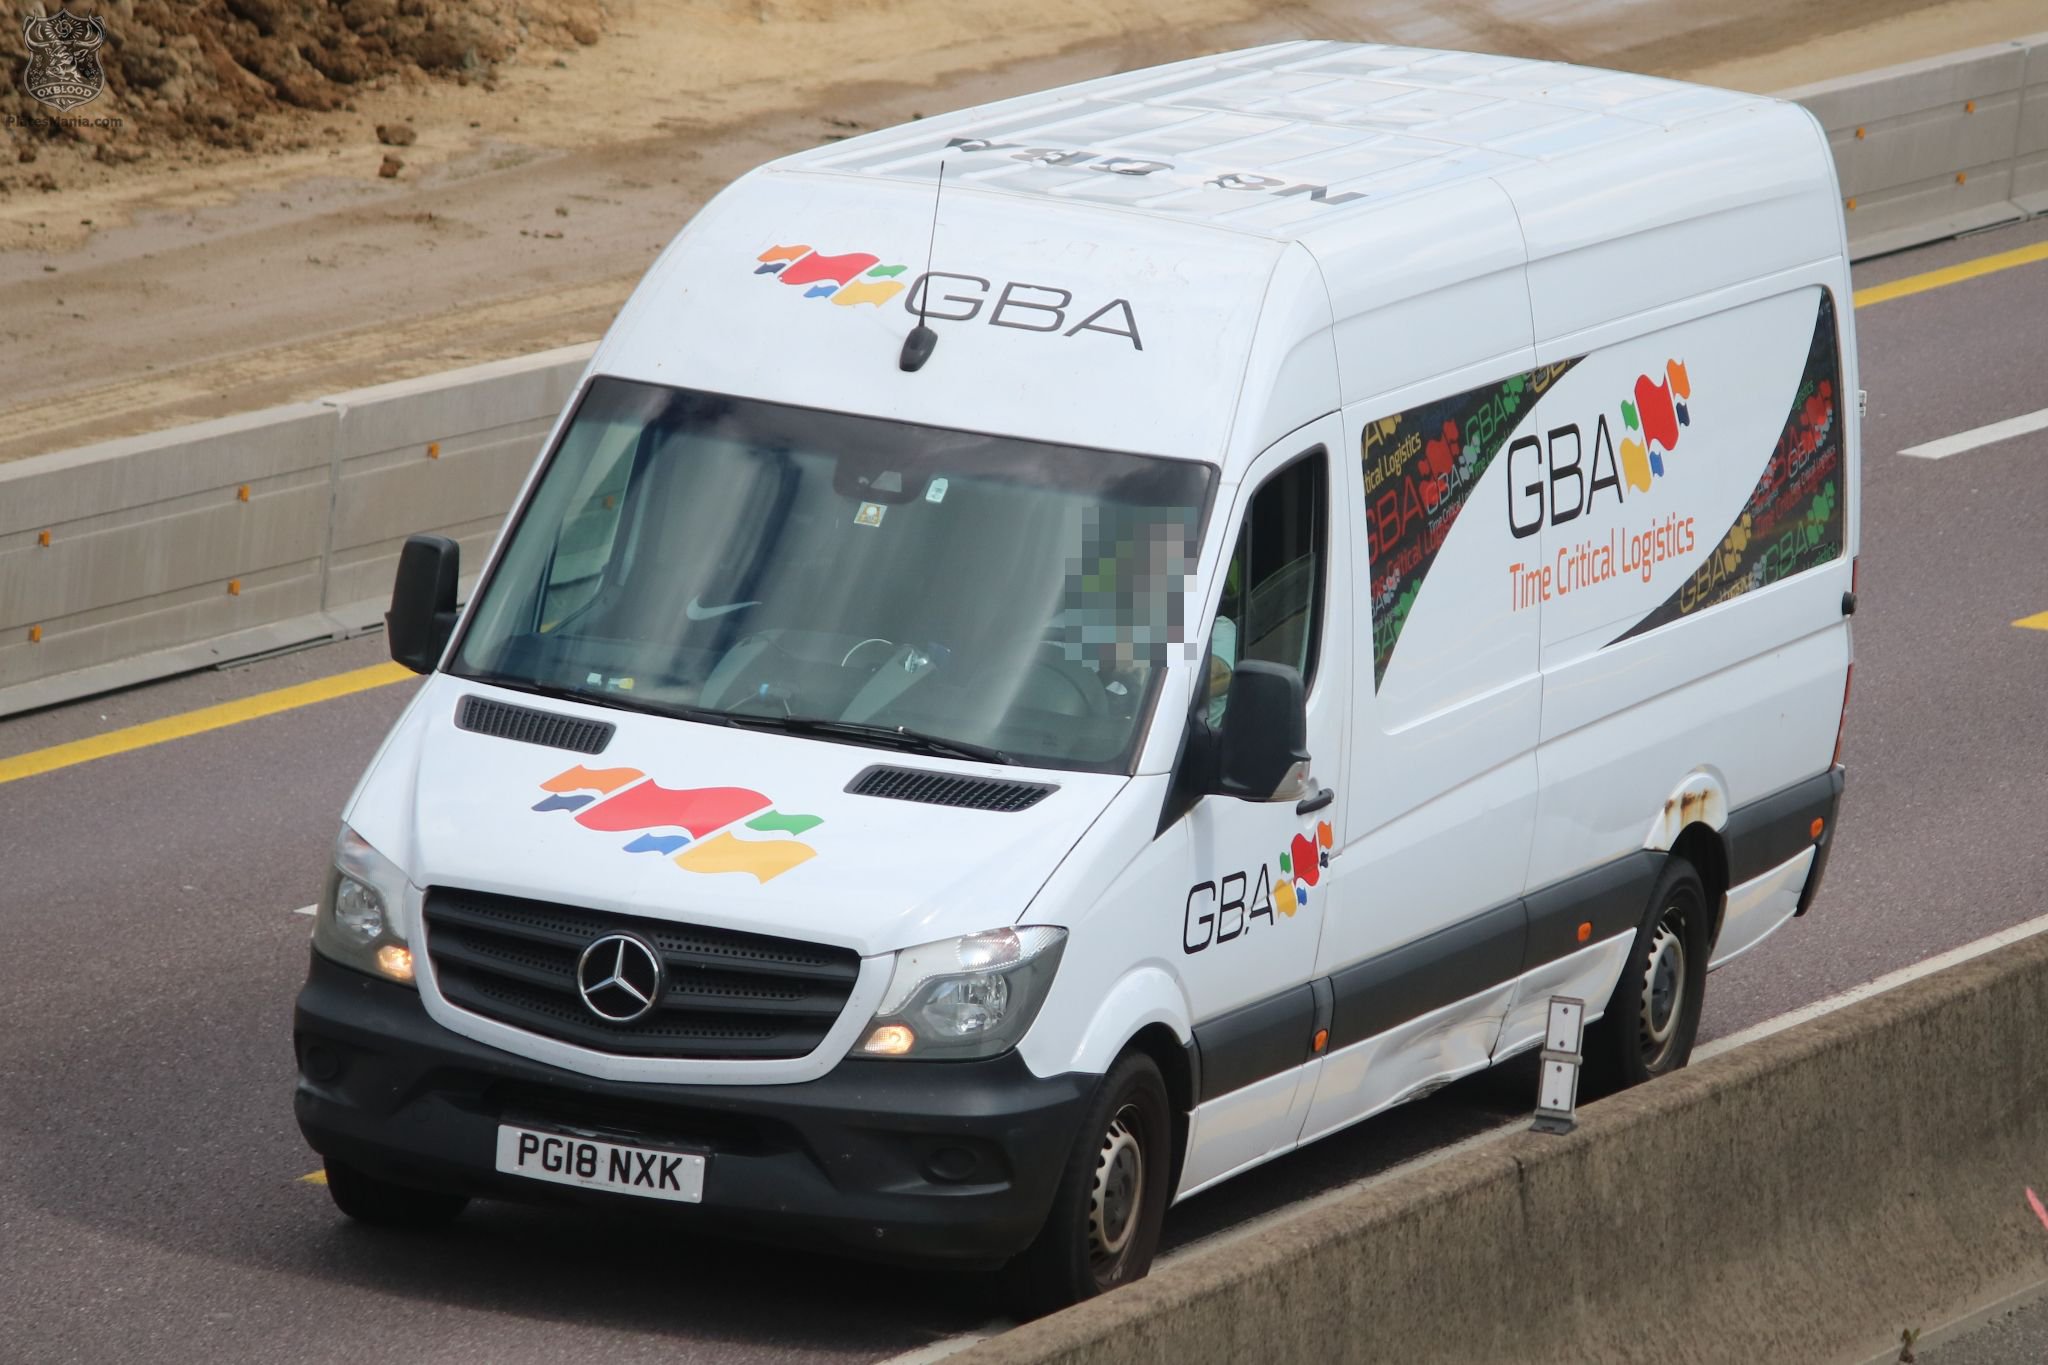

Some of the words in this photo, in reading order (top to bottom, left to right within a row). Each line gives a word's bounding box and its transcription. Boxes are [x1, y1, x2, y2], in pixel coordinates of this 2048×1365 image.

[904, 271, 1143, 351] GBA
[1384, 431, 1422, 476] Logistics
[1507, 413, 1624, 539] GBA
[1509, 562, 1551, 612] Time
[1556, 527, 1617, 596] Critical
[1621, 511, 1695, 584] Logistics
[1183, 863, 1274, 955] GBA
[518, 1132, 598, 1178] PG18
[608, 1148, 683, 1191] NXK
